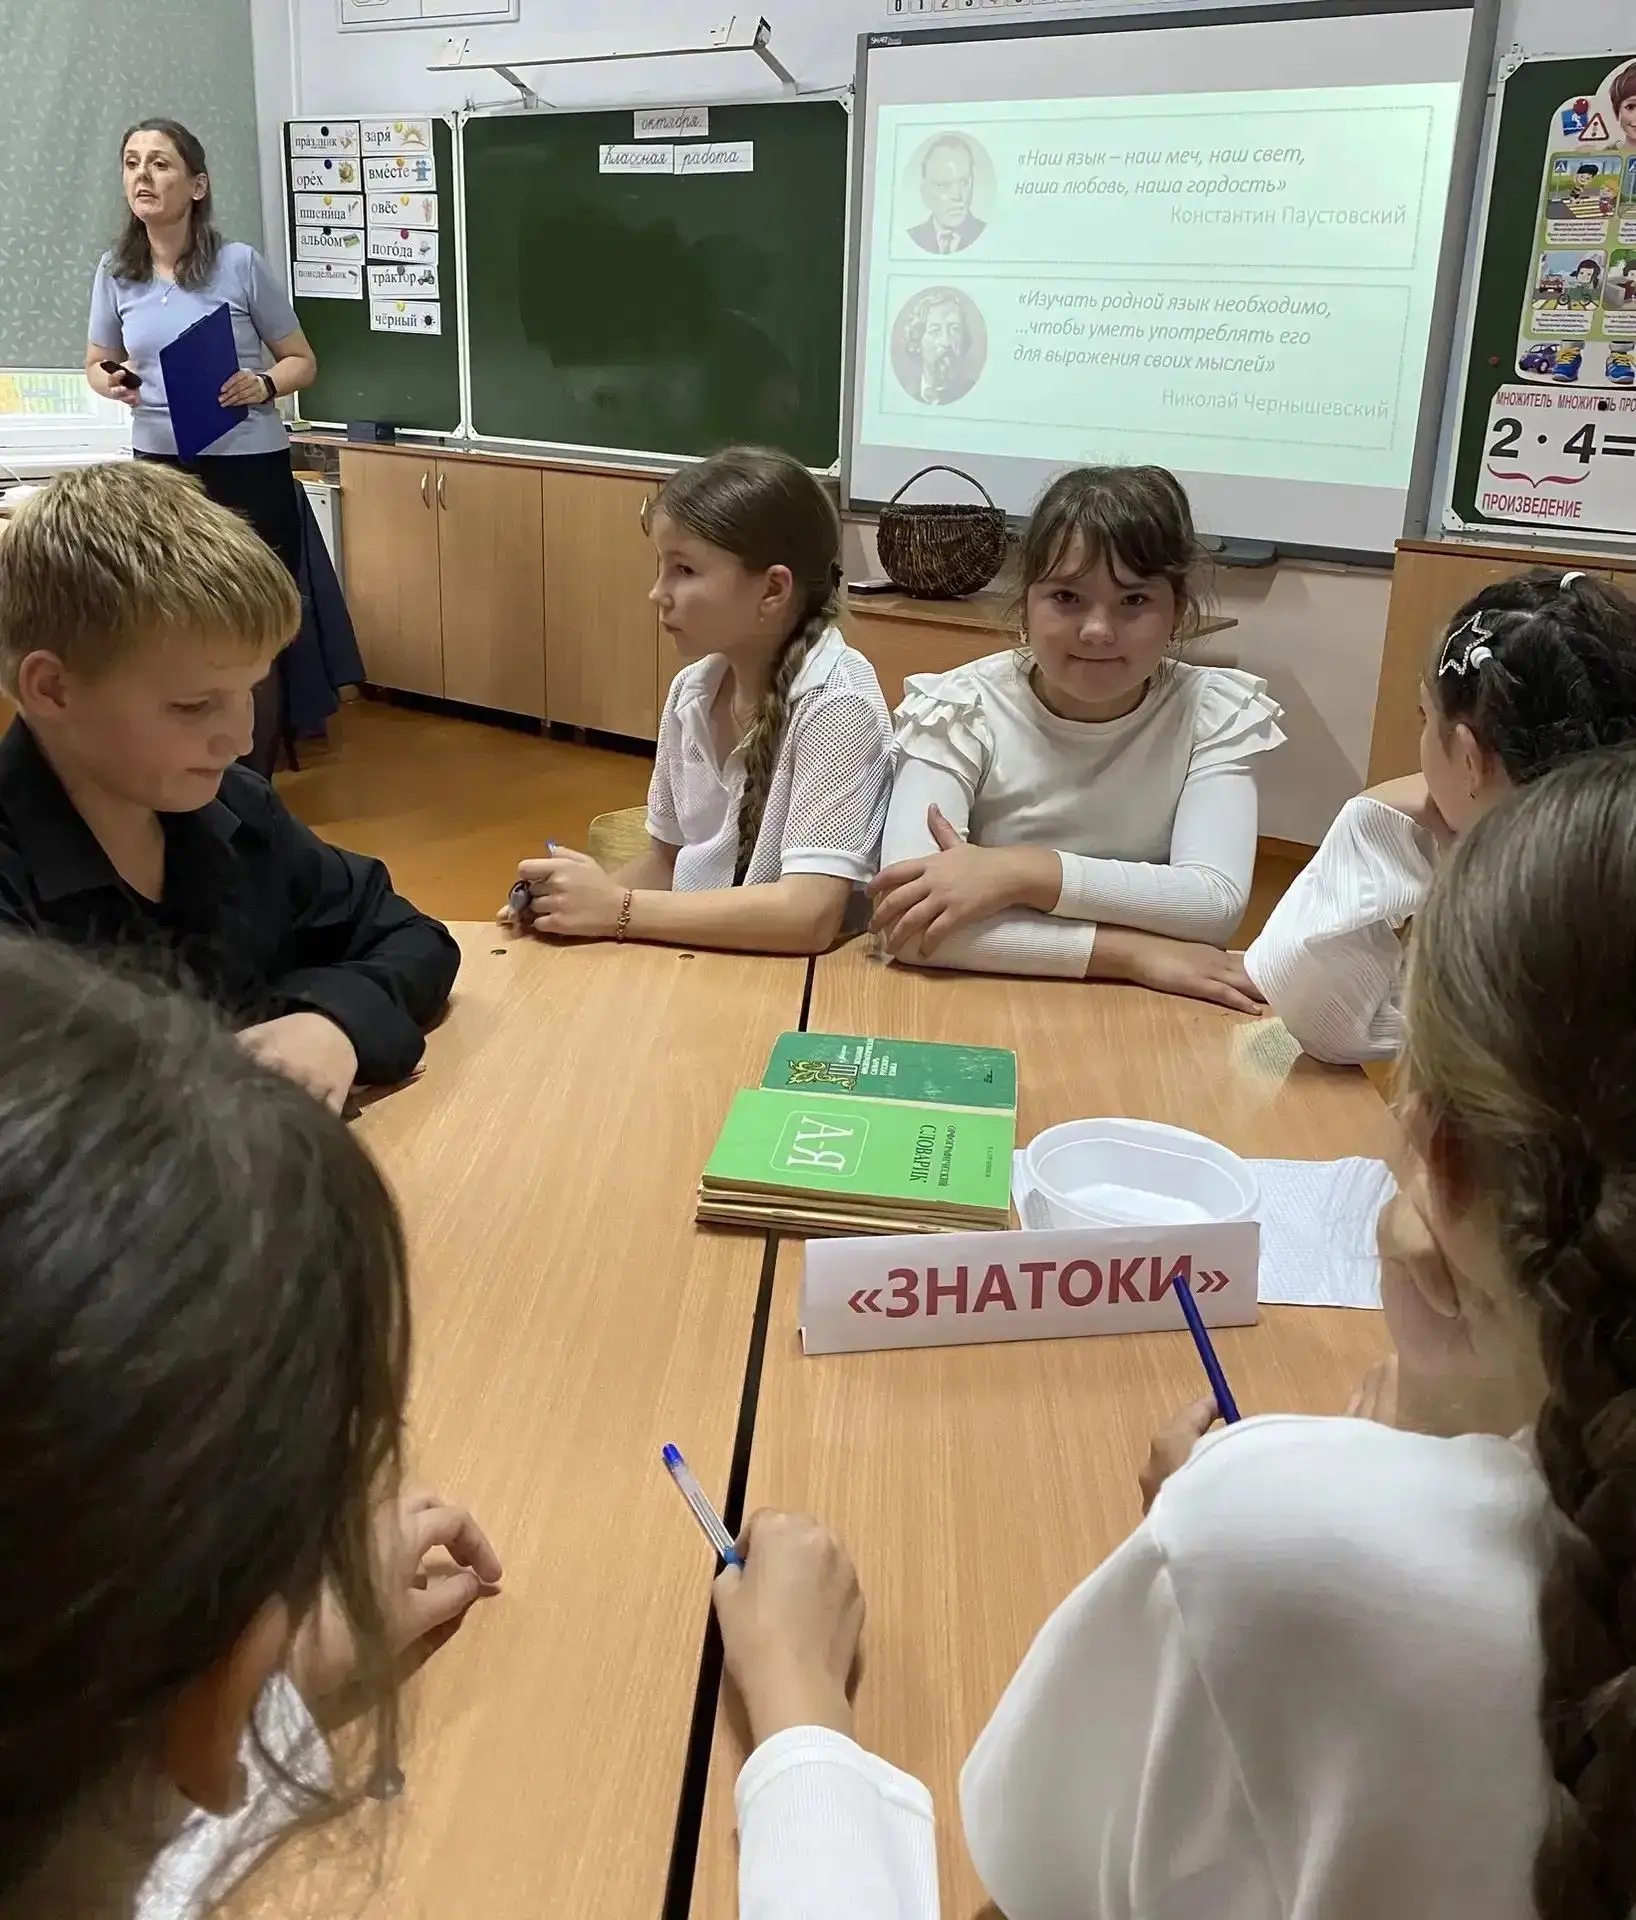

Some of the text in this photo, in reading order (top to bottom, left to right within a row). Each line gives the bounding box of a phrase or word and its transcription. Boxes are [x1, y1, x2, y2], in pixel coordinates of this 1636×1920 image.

[604, 145, 668, 165] Классная
[1018, 150, 1062, 166] «Наш
[1066, 152, 1106, 165] язык
[1125, 151, 1162, 165] наш
[1165, 150, 1203, 168] меч,
[1210, 147, 1248, 164] наш
[1253, 147, 1305, 165] свет,
[1015, 175, 1288, 197] наша любовь, наша гордость»
[371, 201, 398, 214] овёс
[1171, 204, 1406, 228] Константин Паустовский
[1018, 289, 1331, 318] «Изучать родной язык необходимо,
[375, 313, 417, 328] чёрный
[1088, 323, 1145, 340] уметь
[1148, 323, 1275, 343] употреблять
[1280, 330, 1311, 345] его
[1013, 344, 1275, 372] для выражения своих мыслей»
[1162, 388, 1389, 419] Николай Чернышевский
[1496, 392, 1553, 408] МНОЖИТЕЛЬ
[1558, 394, 1617, 411] МНОЖИТЛЬ
[1489, 417, 1523, 459] 2
[1482, 493, 1582, 518] ПРОИЗВЕДЕНИЕ
[909, 1124, 937, 1184] СЛОВАРИК
[848, 1255, 1231, 1318] «ЗНАТОКИ»
